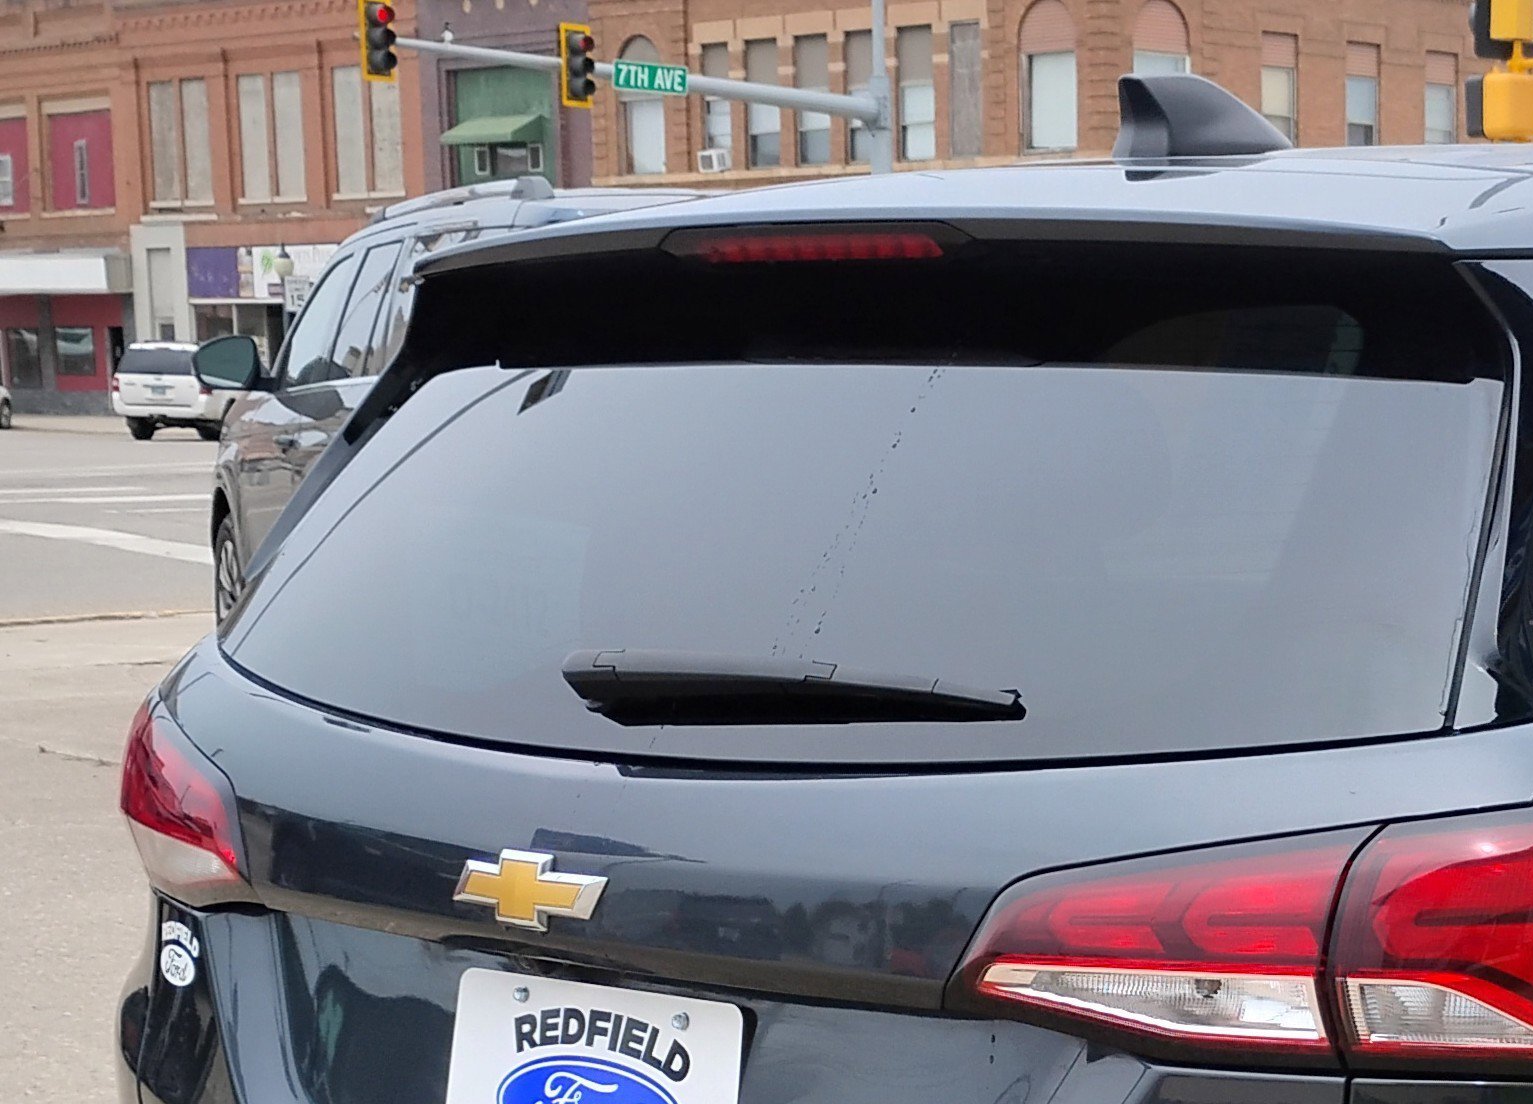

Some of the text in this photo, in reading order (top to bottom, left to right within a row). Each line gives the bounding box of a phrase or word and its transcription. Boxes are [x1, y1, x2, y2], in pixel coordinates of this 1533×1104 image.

[617, 63, 684, 92] 7TH AVE
[513, 1006, 692, 1083] REDFIELD
